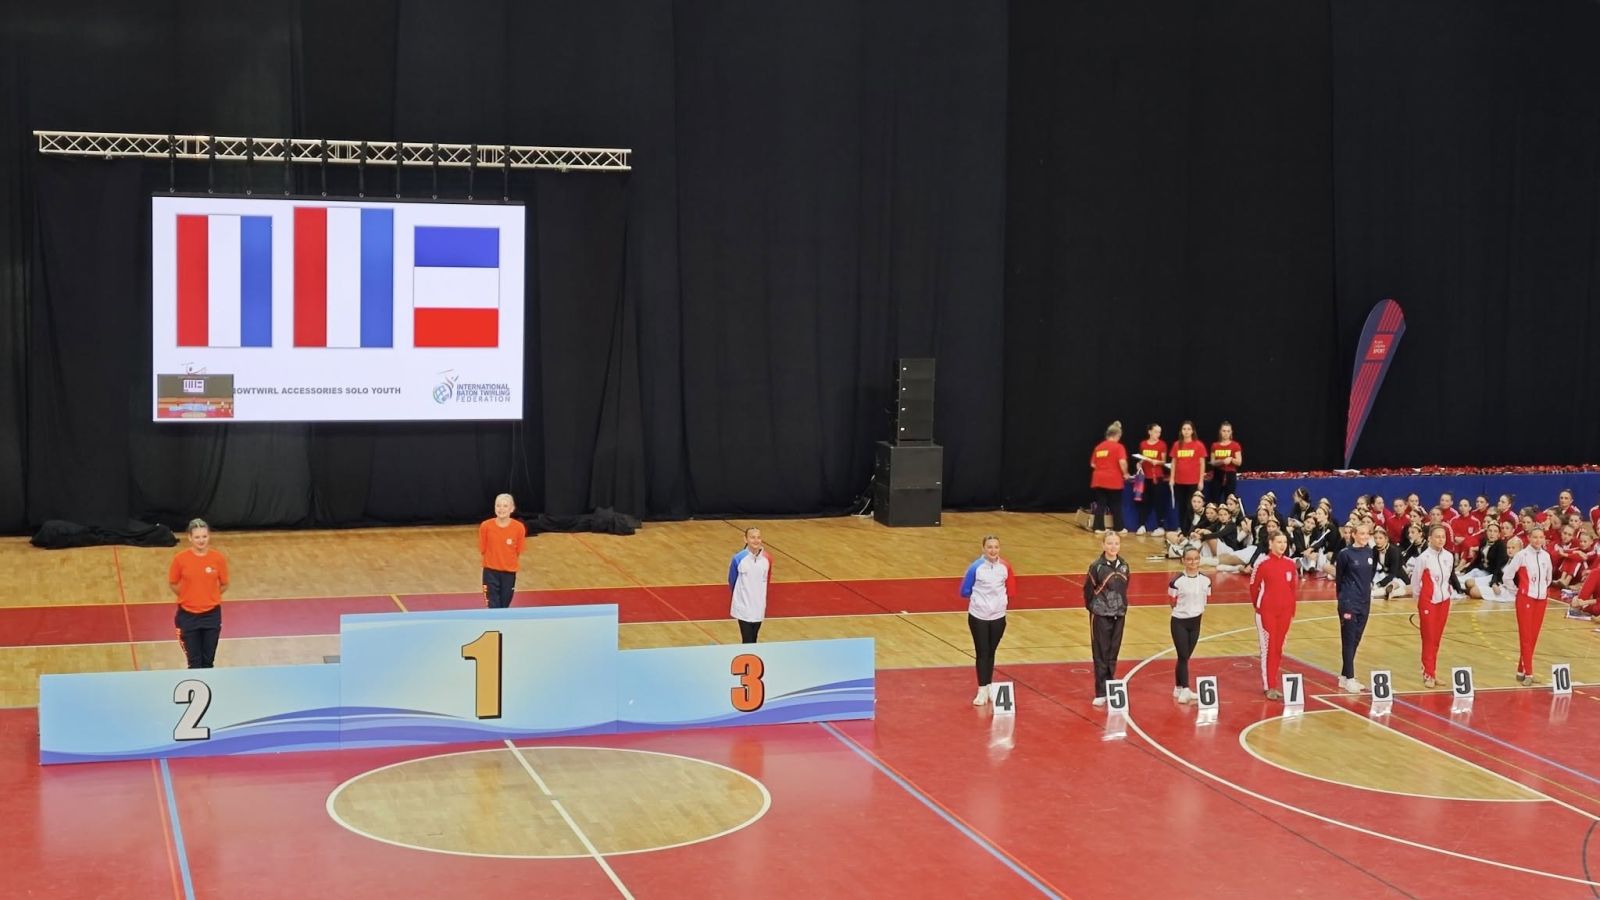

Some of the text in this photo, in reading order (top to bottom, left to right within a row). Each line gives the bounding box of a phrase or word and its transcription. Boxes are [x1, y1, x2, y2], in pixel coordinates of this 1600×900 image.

[281, 387, 343, 395] ACCESSORIES
[345, 387, 369, 395] SOLO
[371, 387, 401, 395] YOUTH
[1177, 449, 1195, 458] STAFF
[1214, 449, 1232, 457] STAFF
[461, 630, 502, 720] 1
[730, 654, 764, 711] 3
[1373, 673, 1390, 700] 8
[1454, 670, 1472, 696] 9
[1553, 667, 1571, 692] 10
[995, 685, 1013, 711] 4
[1108, 682, 1127, 709] 5
[1199, 679, 1217, 706] 6
[1286, 677, 1301, 703] 7
[173, 679, 211, 741] 2
